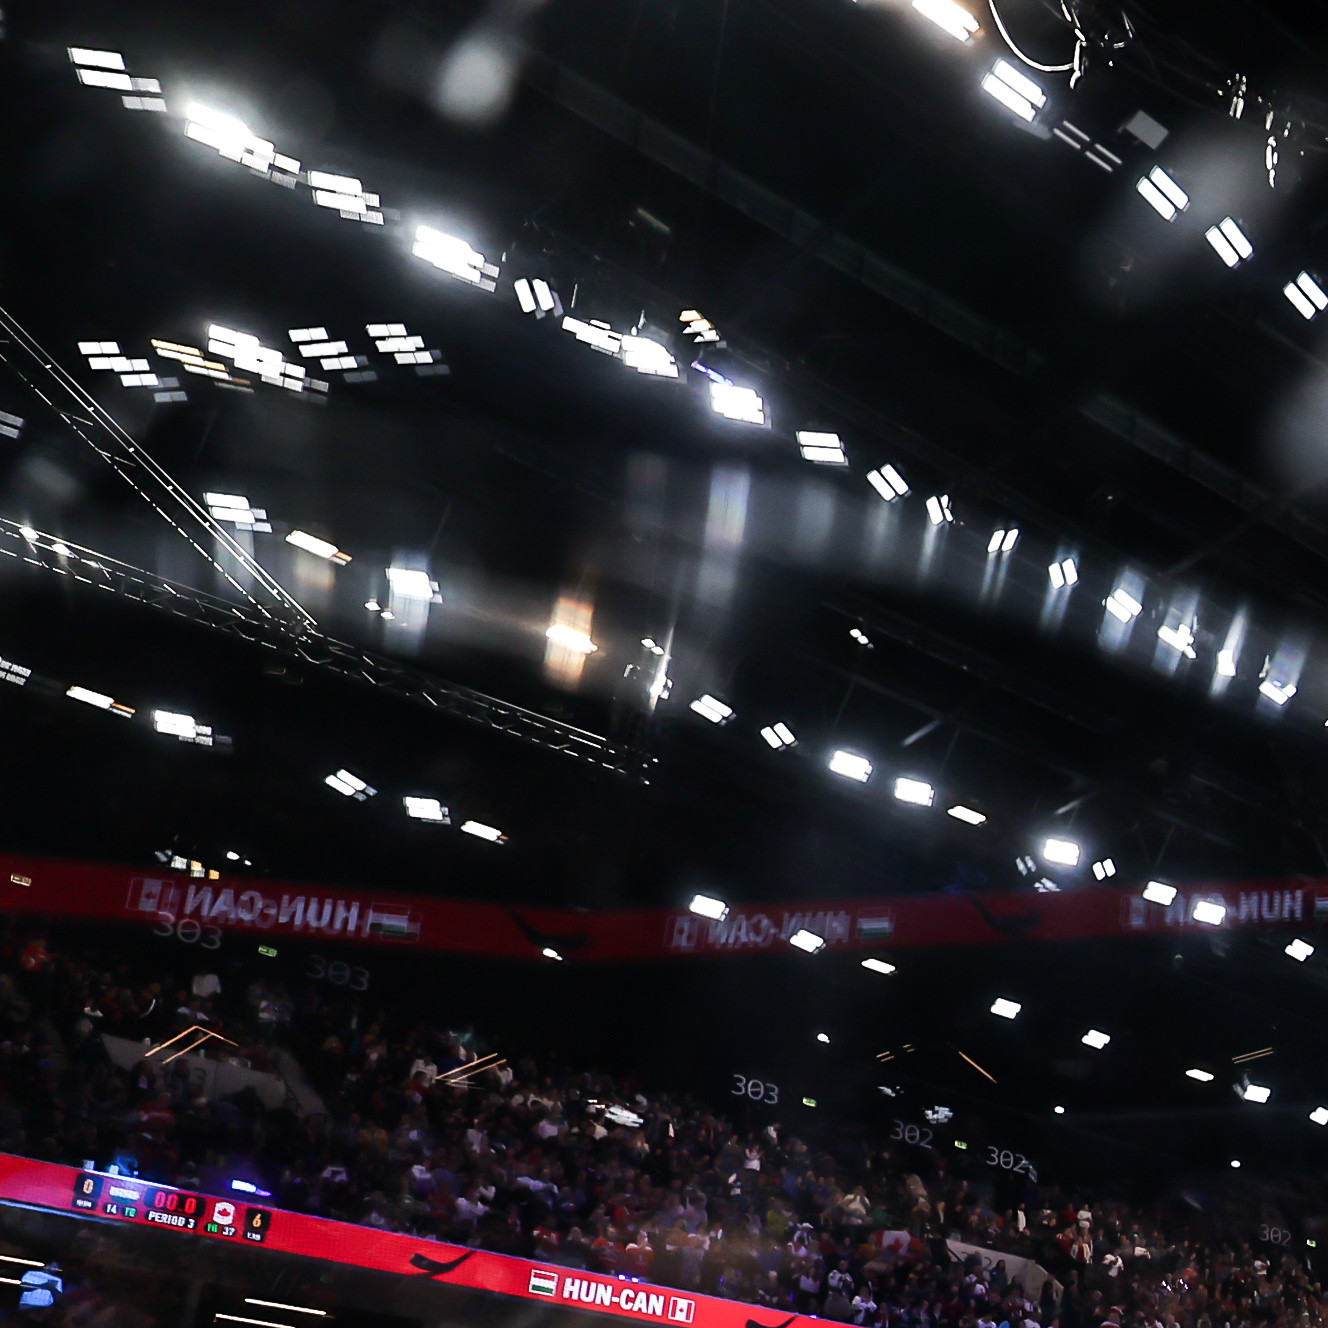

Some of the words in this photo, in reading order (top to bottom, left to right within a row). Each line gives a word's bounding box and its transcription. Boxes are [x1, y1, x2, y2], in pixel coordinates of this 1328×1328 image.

[306, 954, 371, 992] 303
[731, 1074, 780, 1105] 303
[890, 1119, 934, 1150] 302
[985, 1145, 1028, 1175] 302
[148, 1211, 185, 1227] PERIOD
[187, 1218, 195, 1229] 3
[1259, 1223, 1292, 1248] 302
[563, 1276, 664, 1317] HUN-CAN
